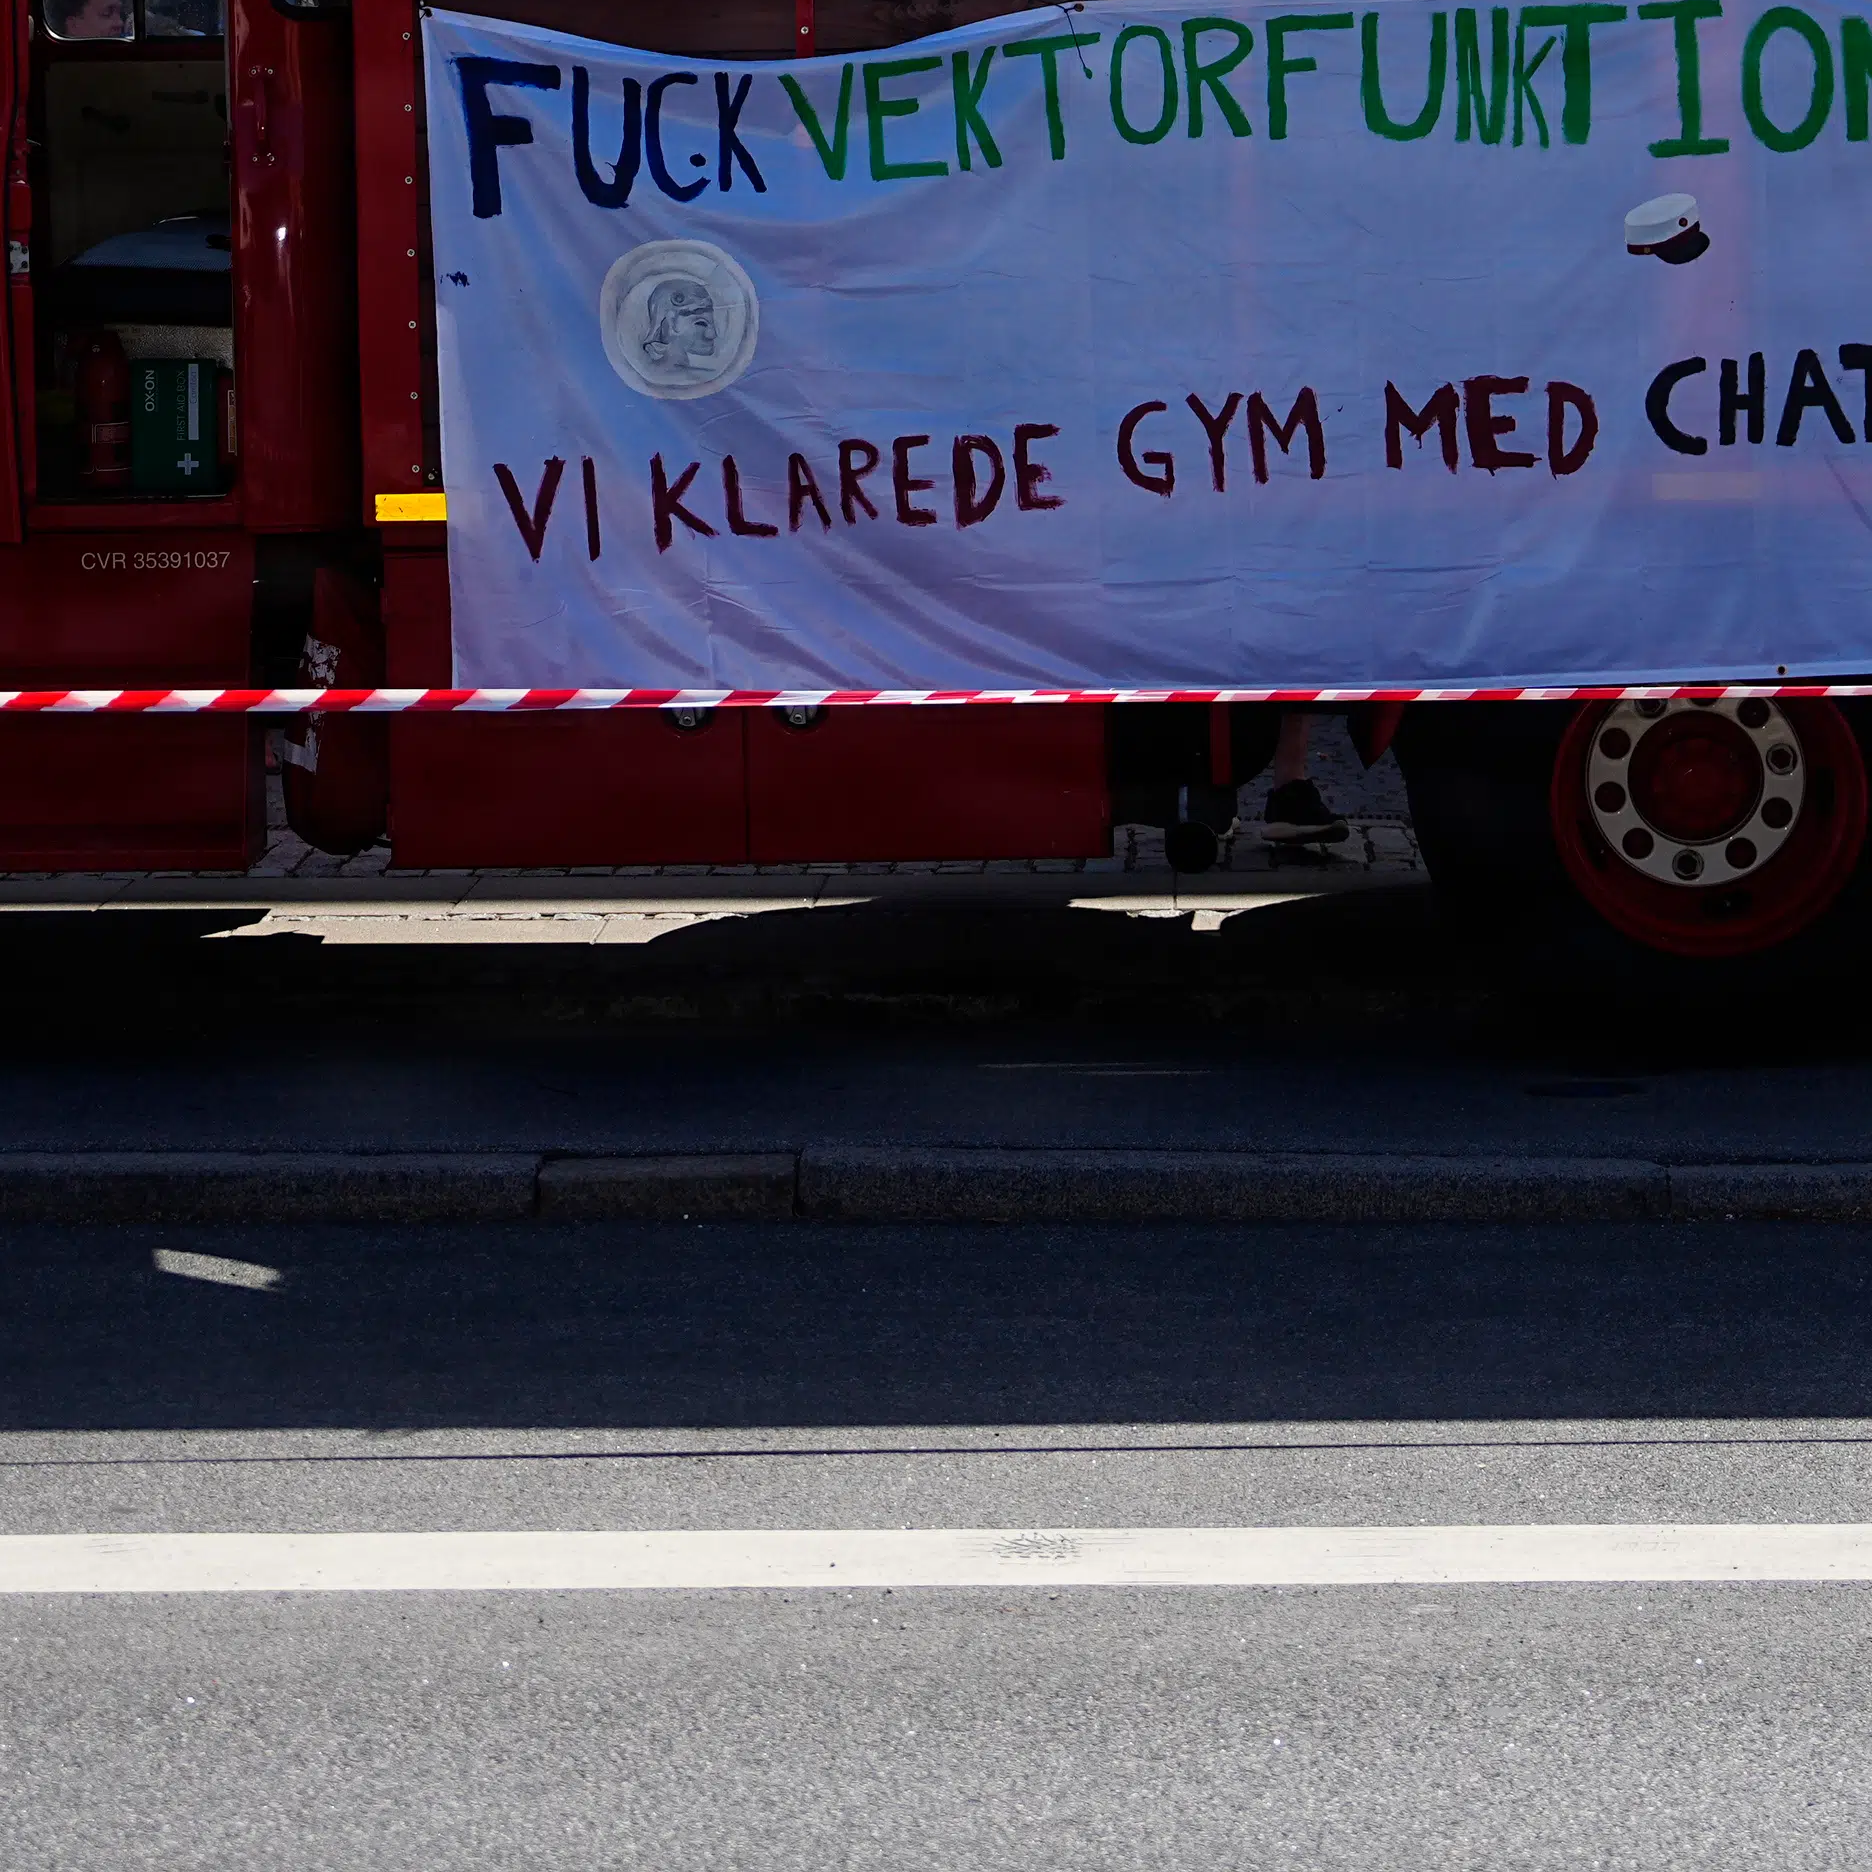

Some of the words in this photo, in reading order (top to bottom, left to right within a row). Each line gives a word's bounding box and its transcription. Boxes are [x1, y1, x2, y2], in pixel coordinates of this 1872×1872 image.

[448, 54, 767, 218] FUCK
[493, 453, 601, 564] VI
[648, 423, 1066, 554] KLAREDE
[1116, 385, 1327, 496] GYM
[1384, 374, 1599, 477] MED
[81, 553, 126, 569] CVR
[133, 552, 230, 570] 35391037
